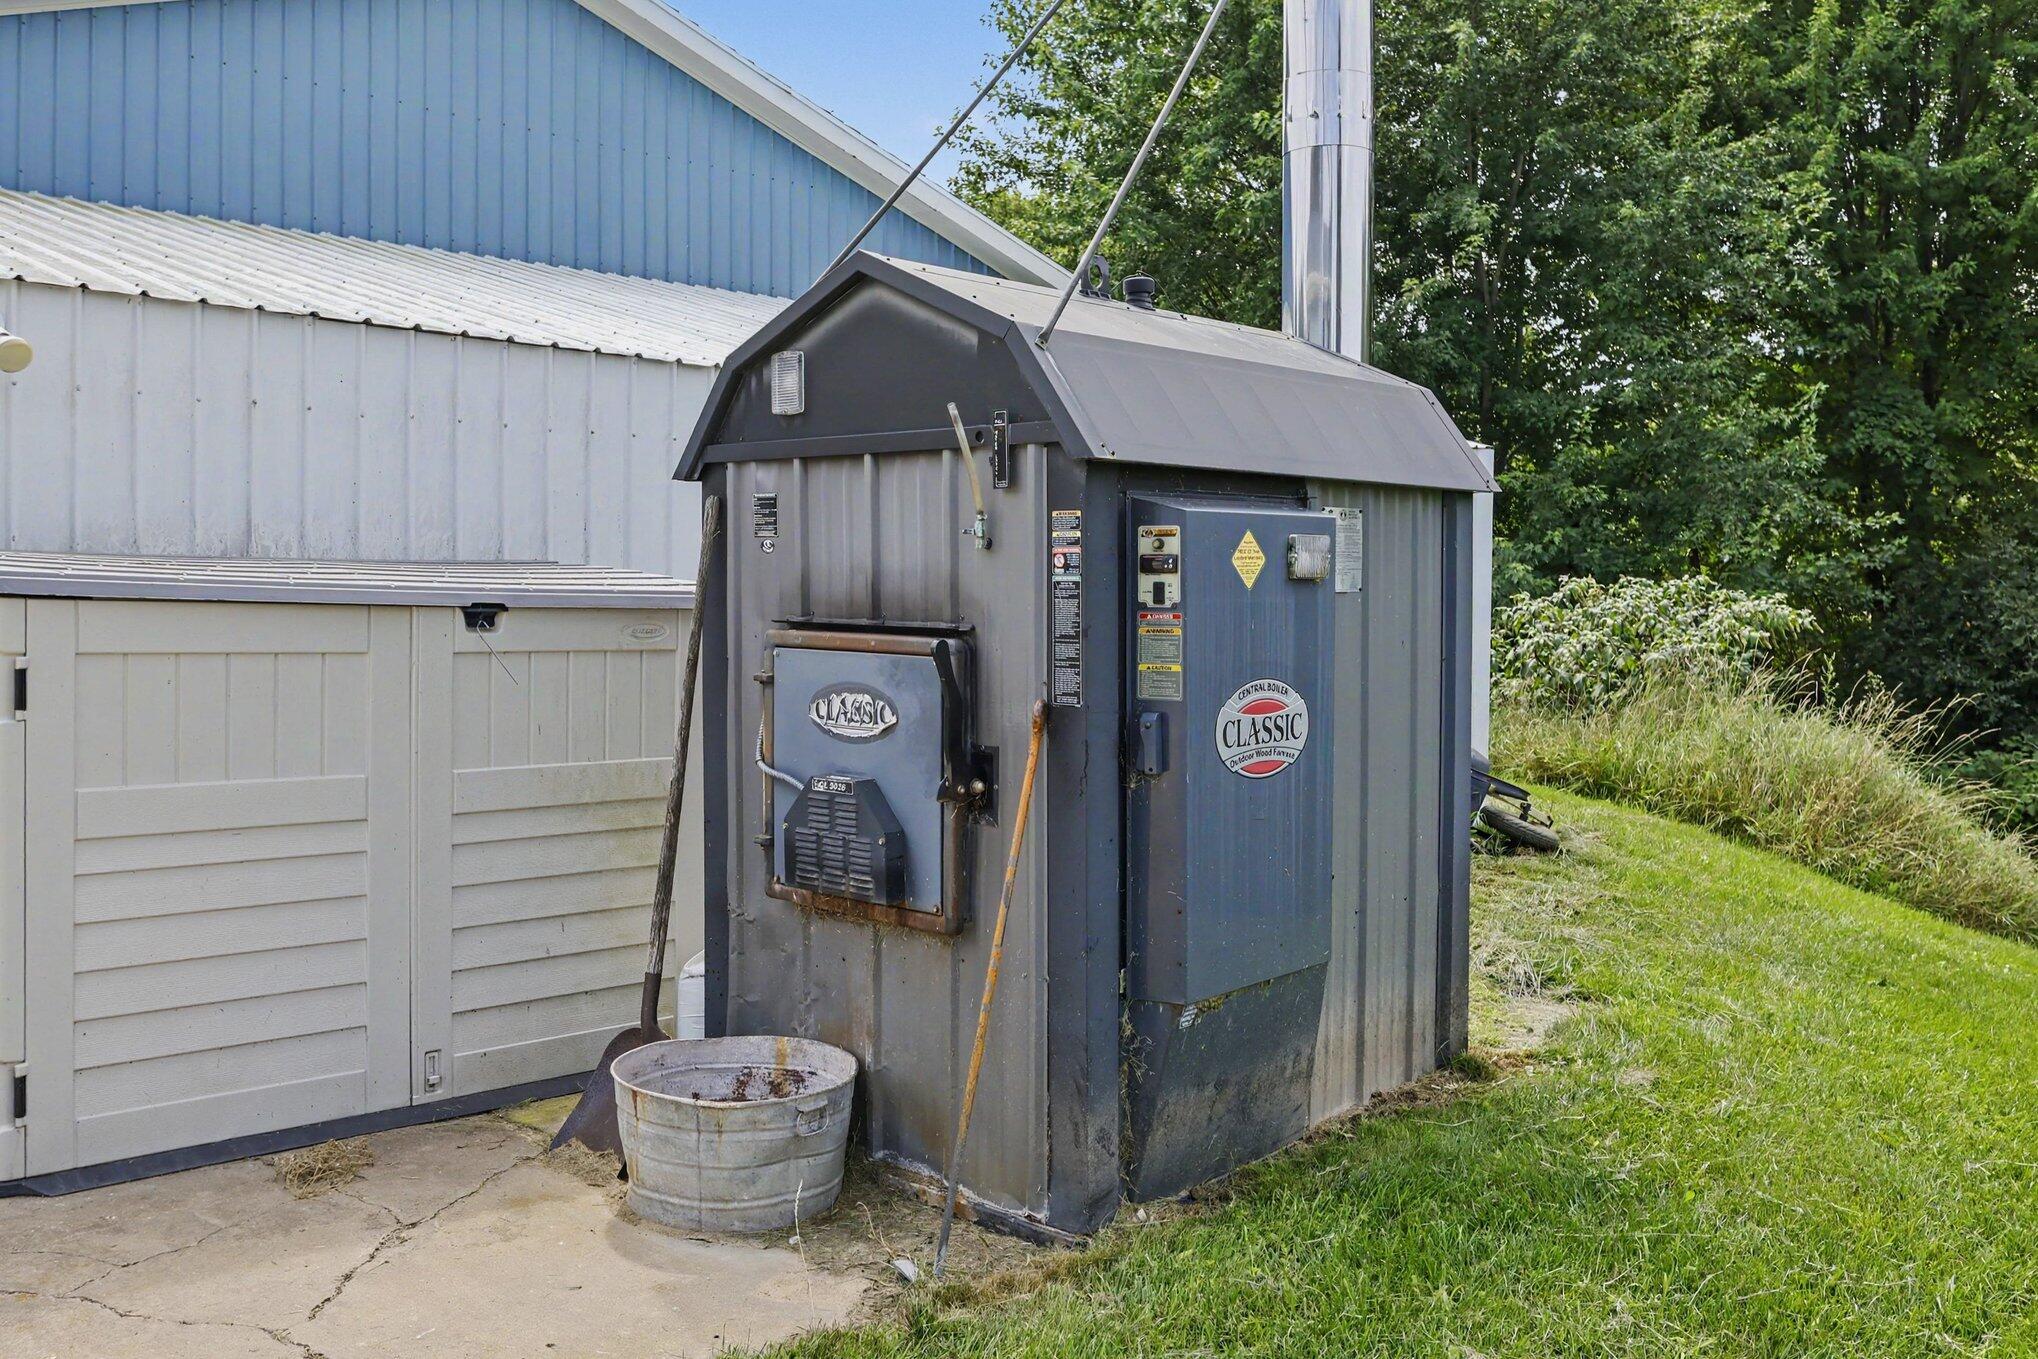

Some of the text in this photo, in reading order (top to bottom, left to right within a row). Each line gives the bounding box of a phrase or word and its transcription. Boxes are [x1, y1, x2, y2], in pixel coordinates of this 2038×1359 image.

[1238, 682, 1288, 700] CENTRAL BOILER
[815, 696, 886, 725] CLASSIC
[1222, 713, 1303, 748] CLASSIC
[1229, 752, 1255, 769] Outdoor
[1255, 748, 1272, 758] Wood
